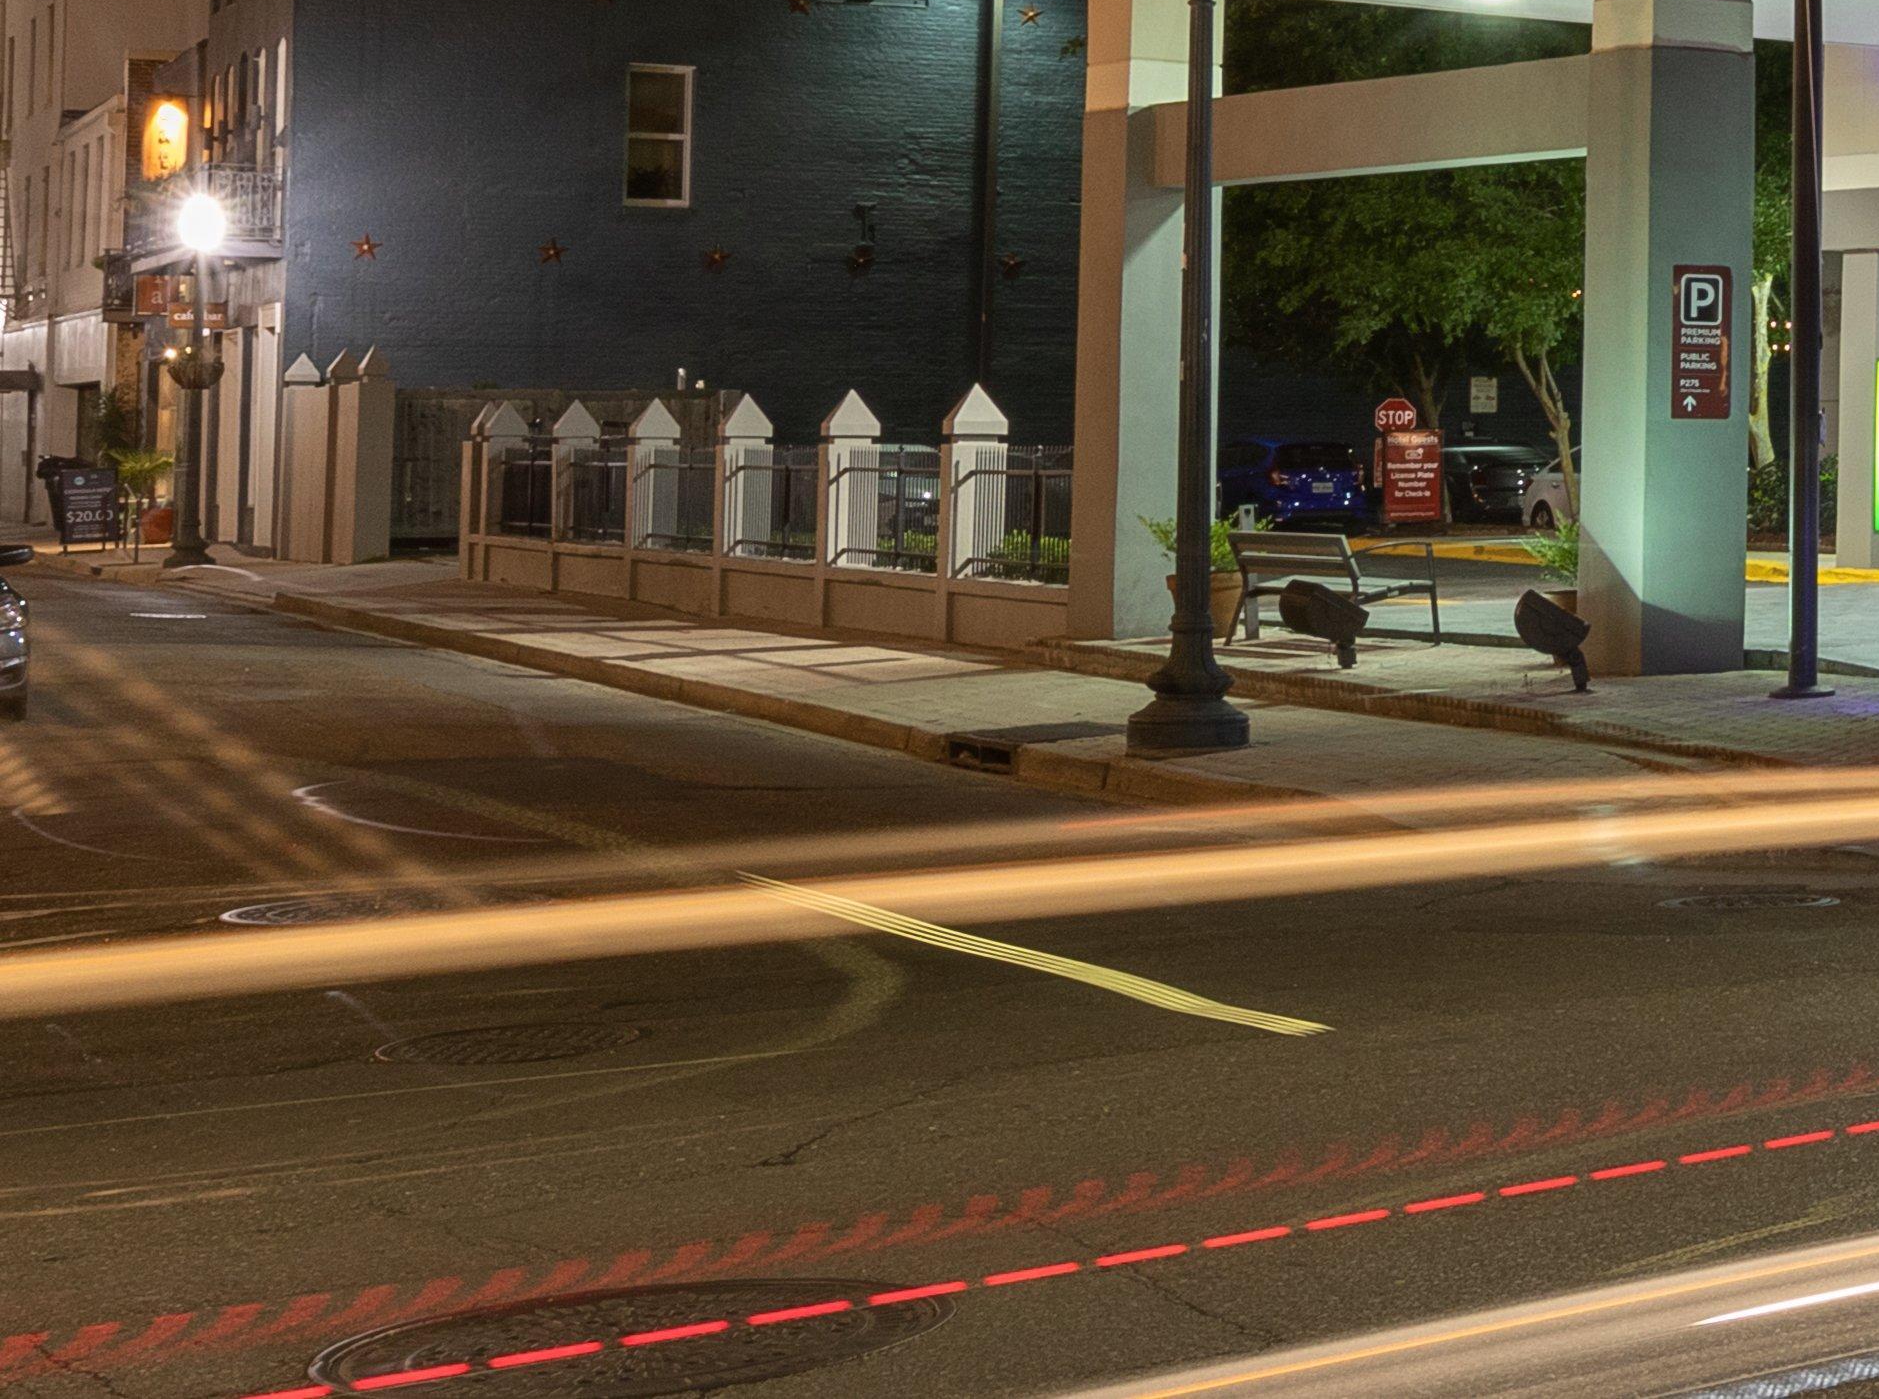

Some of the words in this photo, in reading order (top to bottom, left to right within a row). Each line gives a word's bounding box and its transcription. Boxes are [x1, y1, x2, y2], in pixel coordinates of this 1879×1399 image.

[1690, 281, 1716, 318] P
[1681, 327, 1722, 337] PREMIUM
[1680, 336, 1721, 345] PARKING
[1680, 353, 1710, 361] PUBLIC
[1680, 361, 1717, 370] PARKING
[1378, 410, 1414, 425] STOP
